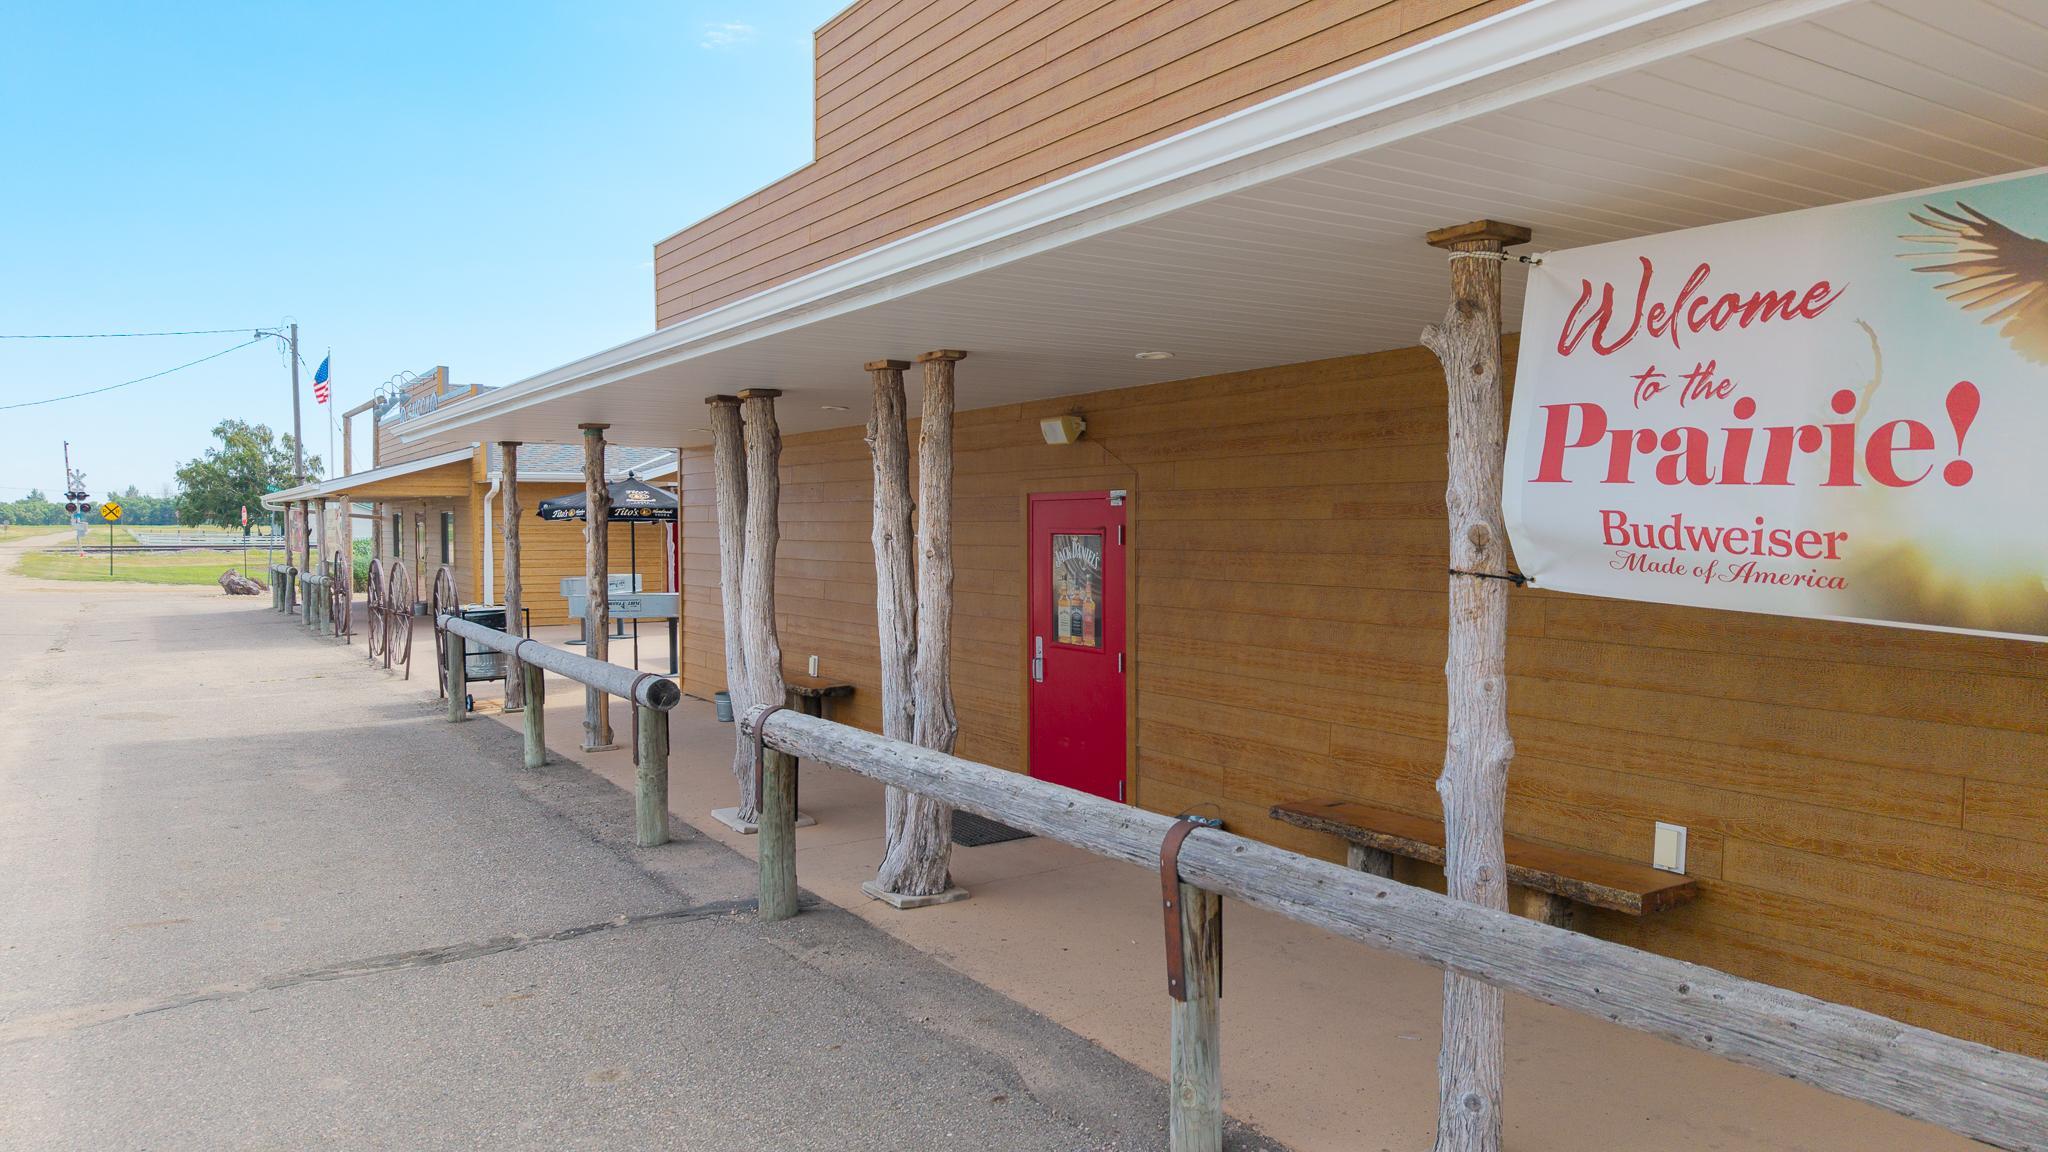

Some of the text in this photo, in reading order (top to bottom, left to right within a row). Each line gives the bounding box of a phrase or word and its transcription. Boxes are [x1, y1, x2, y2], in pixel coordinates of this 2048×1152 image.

[1557, 256, 1850, 357] Welcome
[1630, 359, 1738, 409] to the
[1528, 380, 1981, 487] Prairie!
[614, 507, 640, 517] Tito's
[1599, 510, 1848, 560] Budweiser
[1055, 541, 1100, 570] JACK DANIEL'S
[1609, 550, 1849, 590] Made of America
